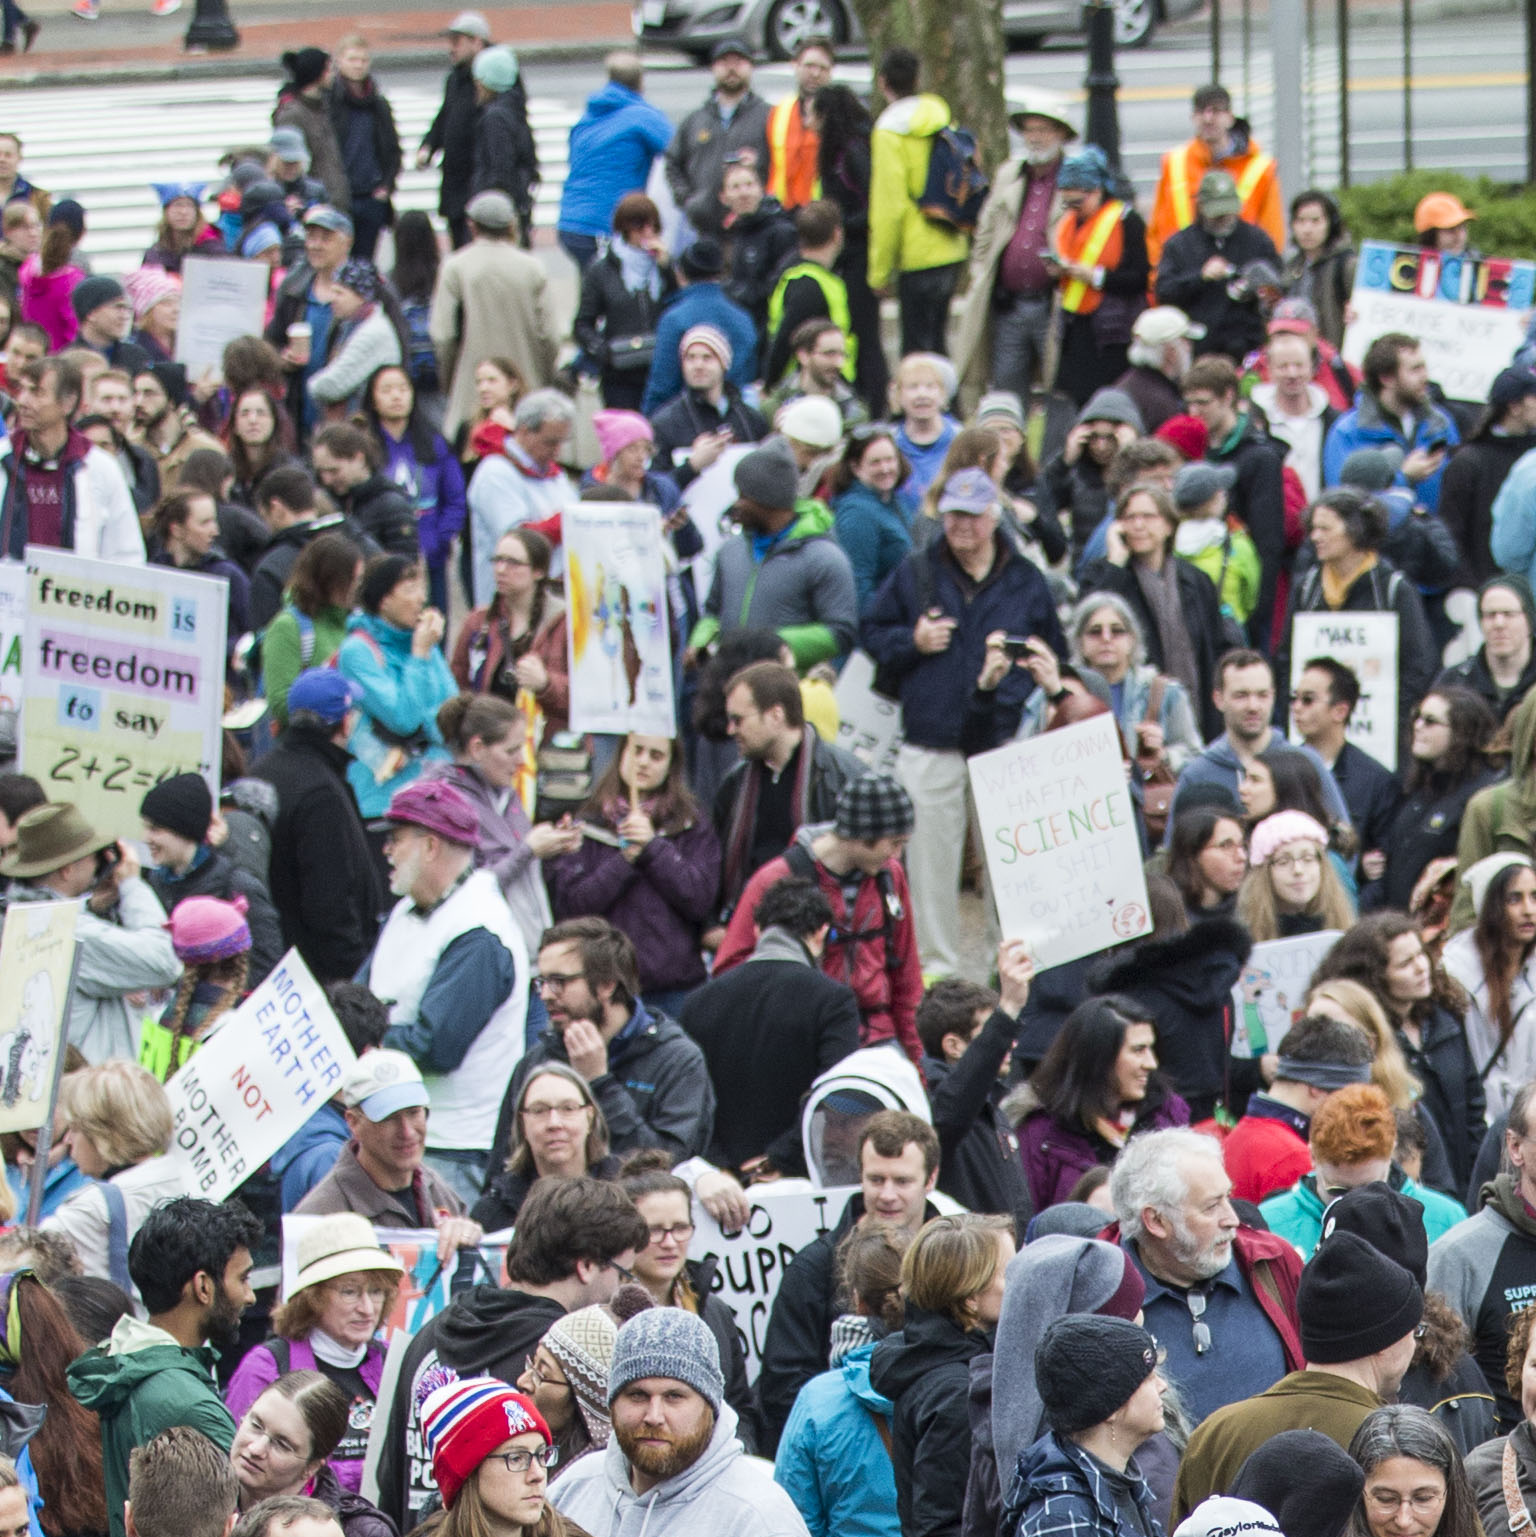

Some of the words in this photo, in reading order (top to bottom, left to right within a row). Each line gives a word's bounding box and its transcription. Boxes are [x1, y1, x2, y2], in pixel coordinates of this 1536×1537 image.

[172, 606, 196, 632] is
[1316, 626, 1367, 648] MAKE
[40, 639, 195, 695] freedom
[65, 696, 94, 721] to
[114, 709, 164, 740] say
[1006, 774, 1088, 816] HAFTA
[995, 791, 1127, 865] SCIENCE
[1055, 836, 1114, 884] SHIT
[255, 1000, 317, 1107] EARTH
[271, 967, 342, 1086] MOTHER
[229, 1064, 274, 1122] NOT
[180, 1066, 247, 1184] MOTHER
